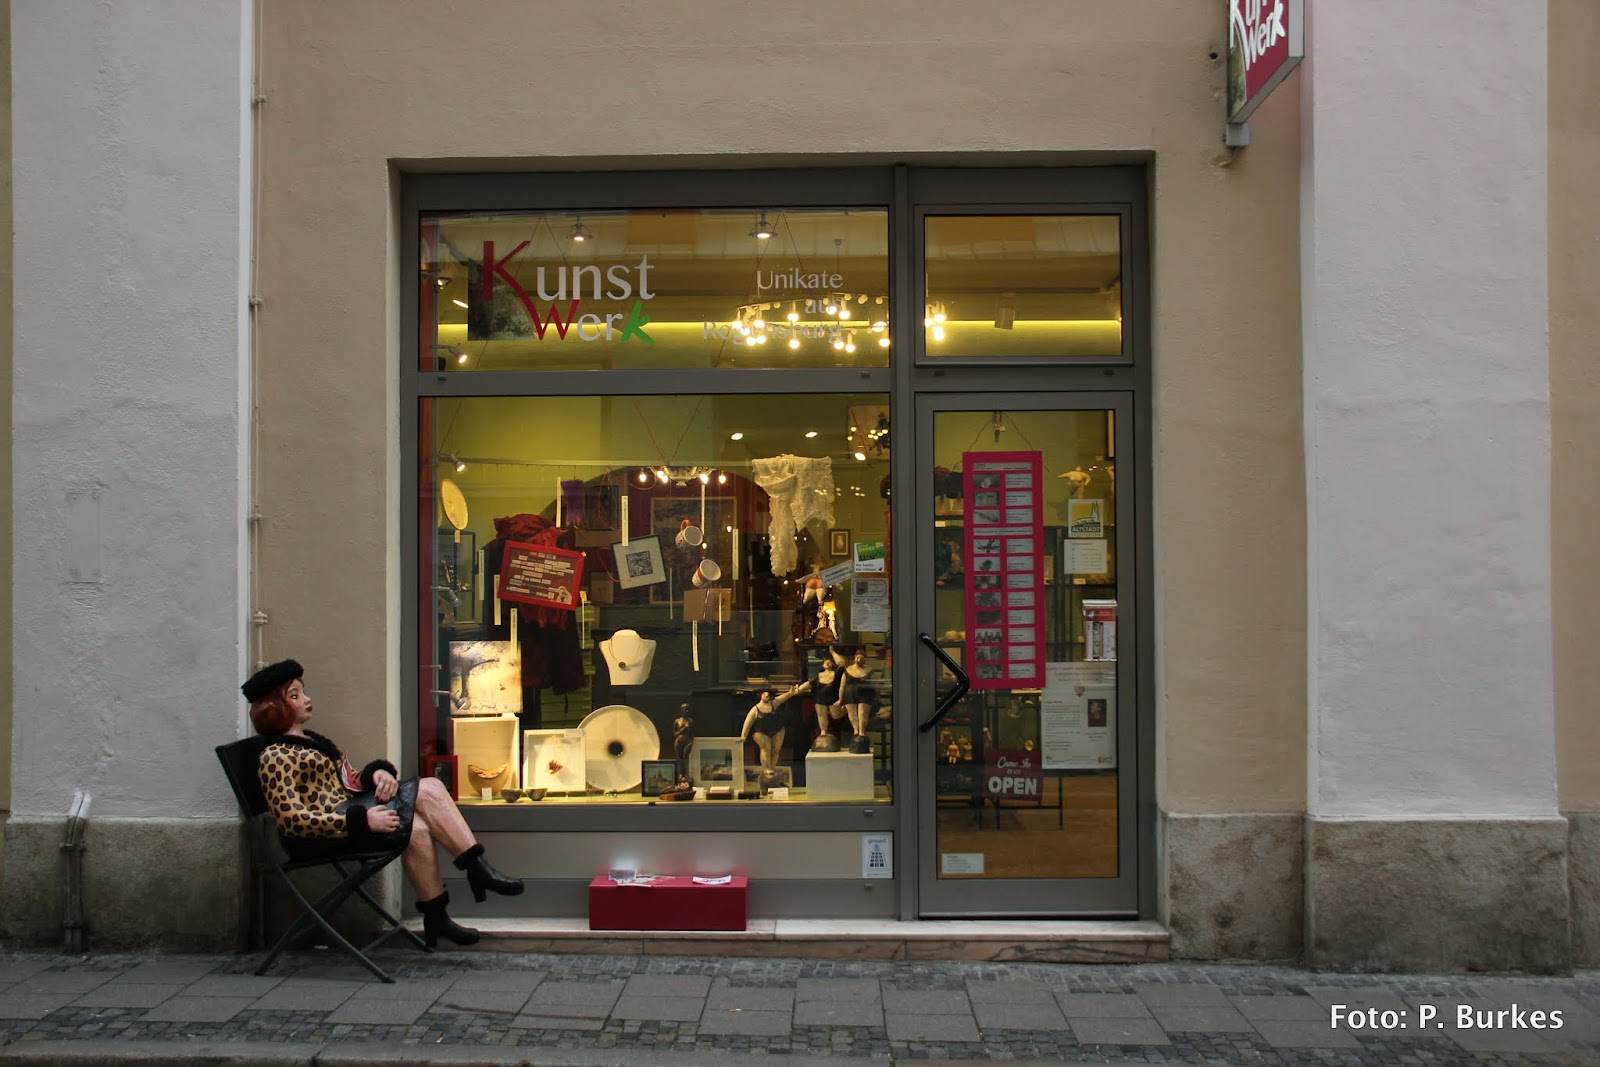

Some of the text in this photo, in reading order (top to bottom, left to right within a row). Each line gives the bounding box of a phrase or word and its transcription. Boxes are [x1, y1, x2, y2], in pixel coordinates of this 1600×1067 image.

[482, 240, 656, 302] Kunst
[757, 268, 843, 289] Unikate
[804, 297, 843, 315] aus
[526, 299, 657, 346] Werk
[703, 320, 843, 346] Regensburg
[997, 756, 1018, 769] Come
[988, 776, 1037, 796] OPEN
